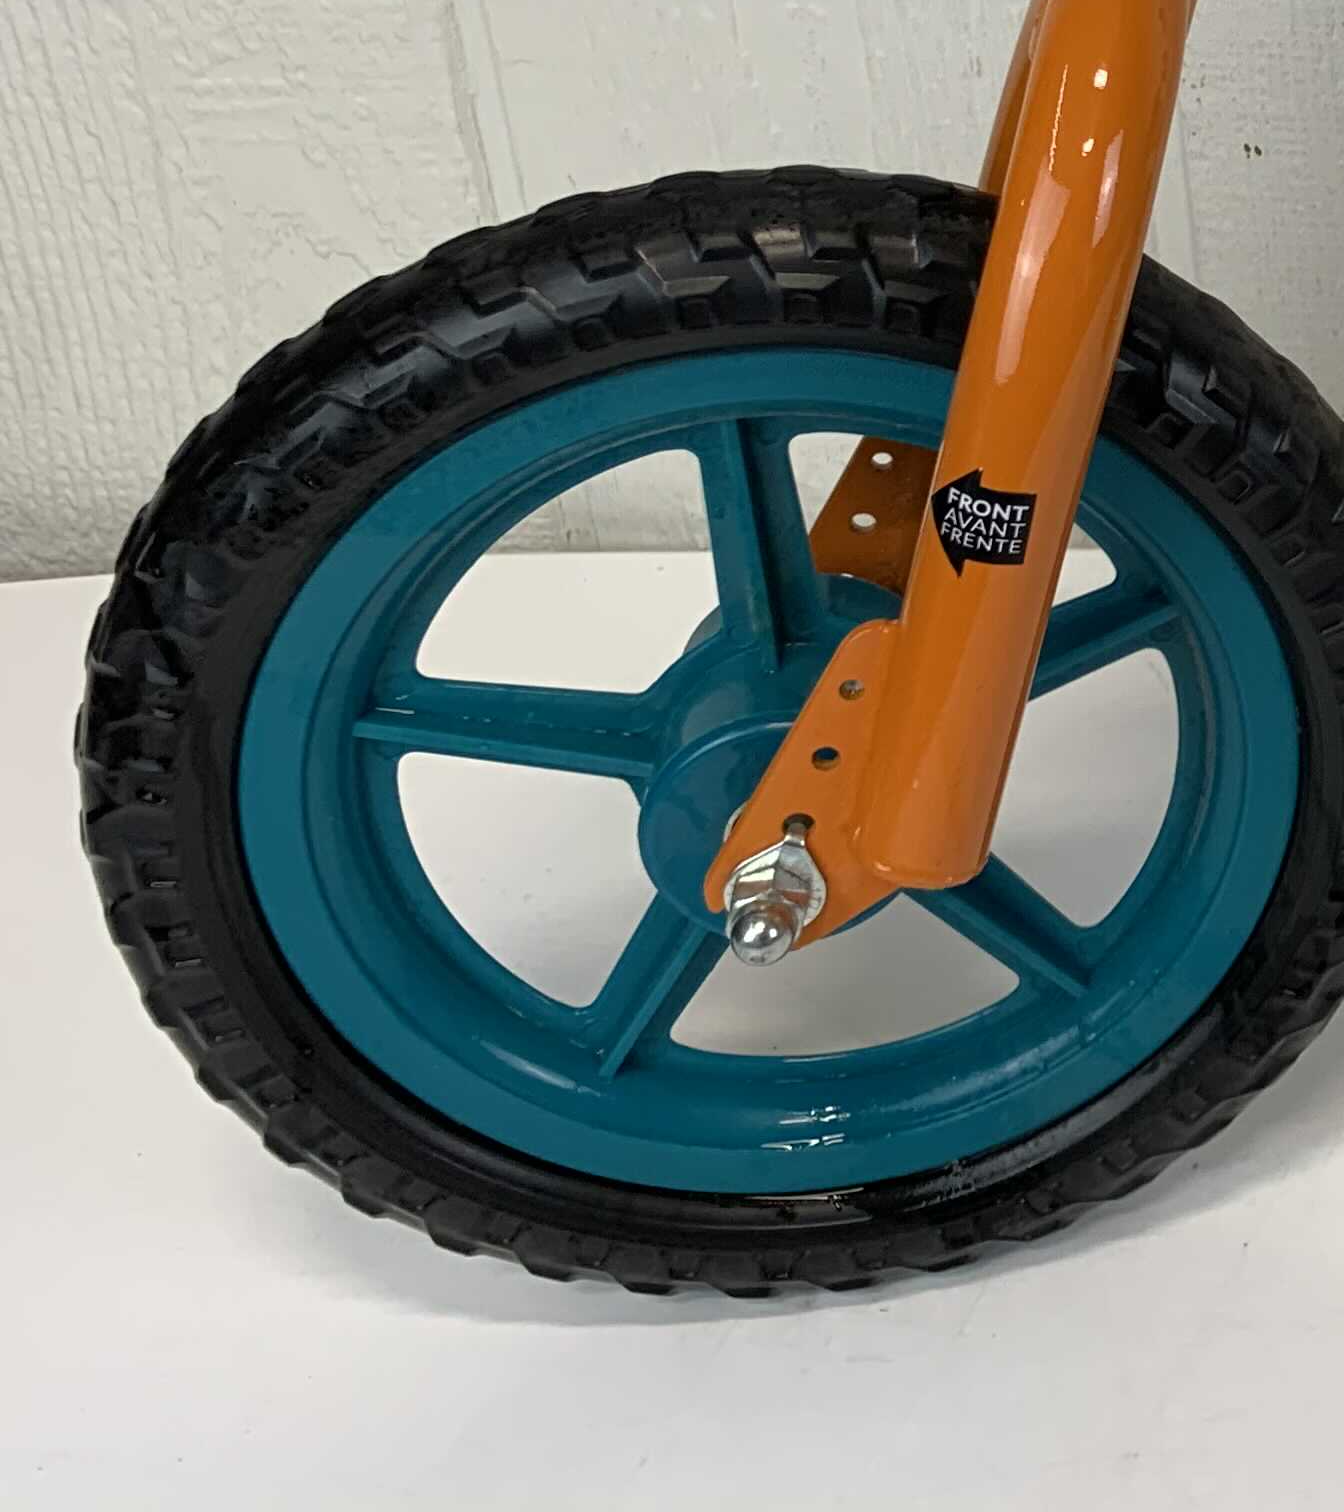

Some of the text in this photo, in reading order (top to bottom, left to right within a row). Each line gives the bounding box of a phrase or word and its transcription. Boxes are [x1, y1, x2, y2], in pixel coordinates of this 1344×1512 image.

[947, 487, 1030, 522] FRONT
[940, 522, 1022, 554] FRENTE
[944, 507, 1027, 538] AVANT
